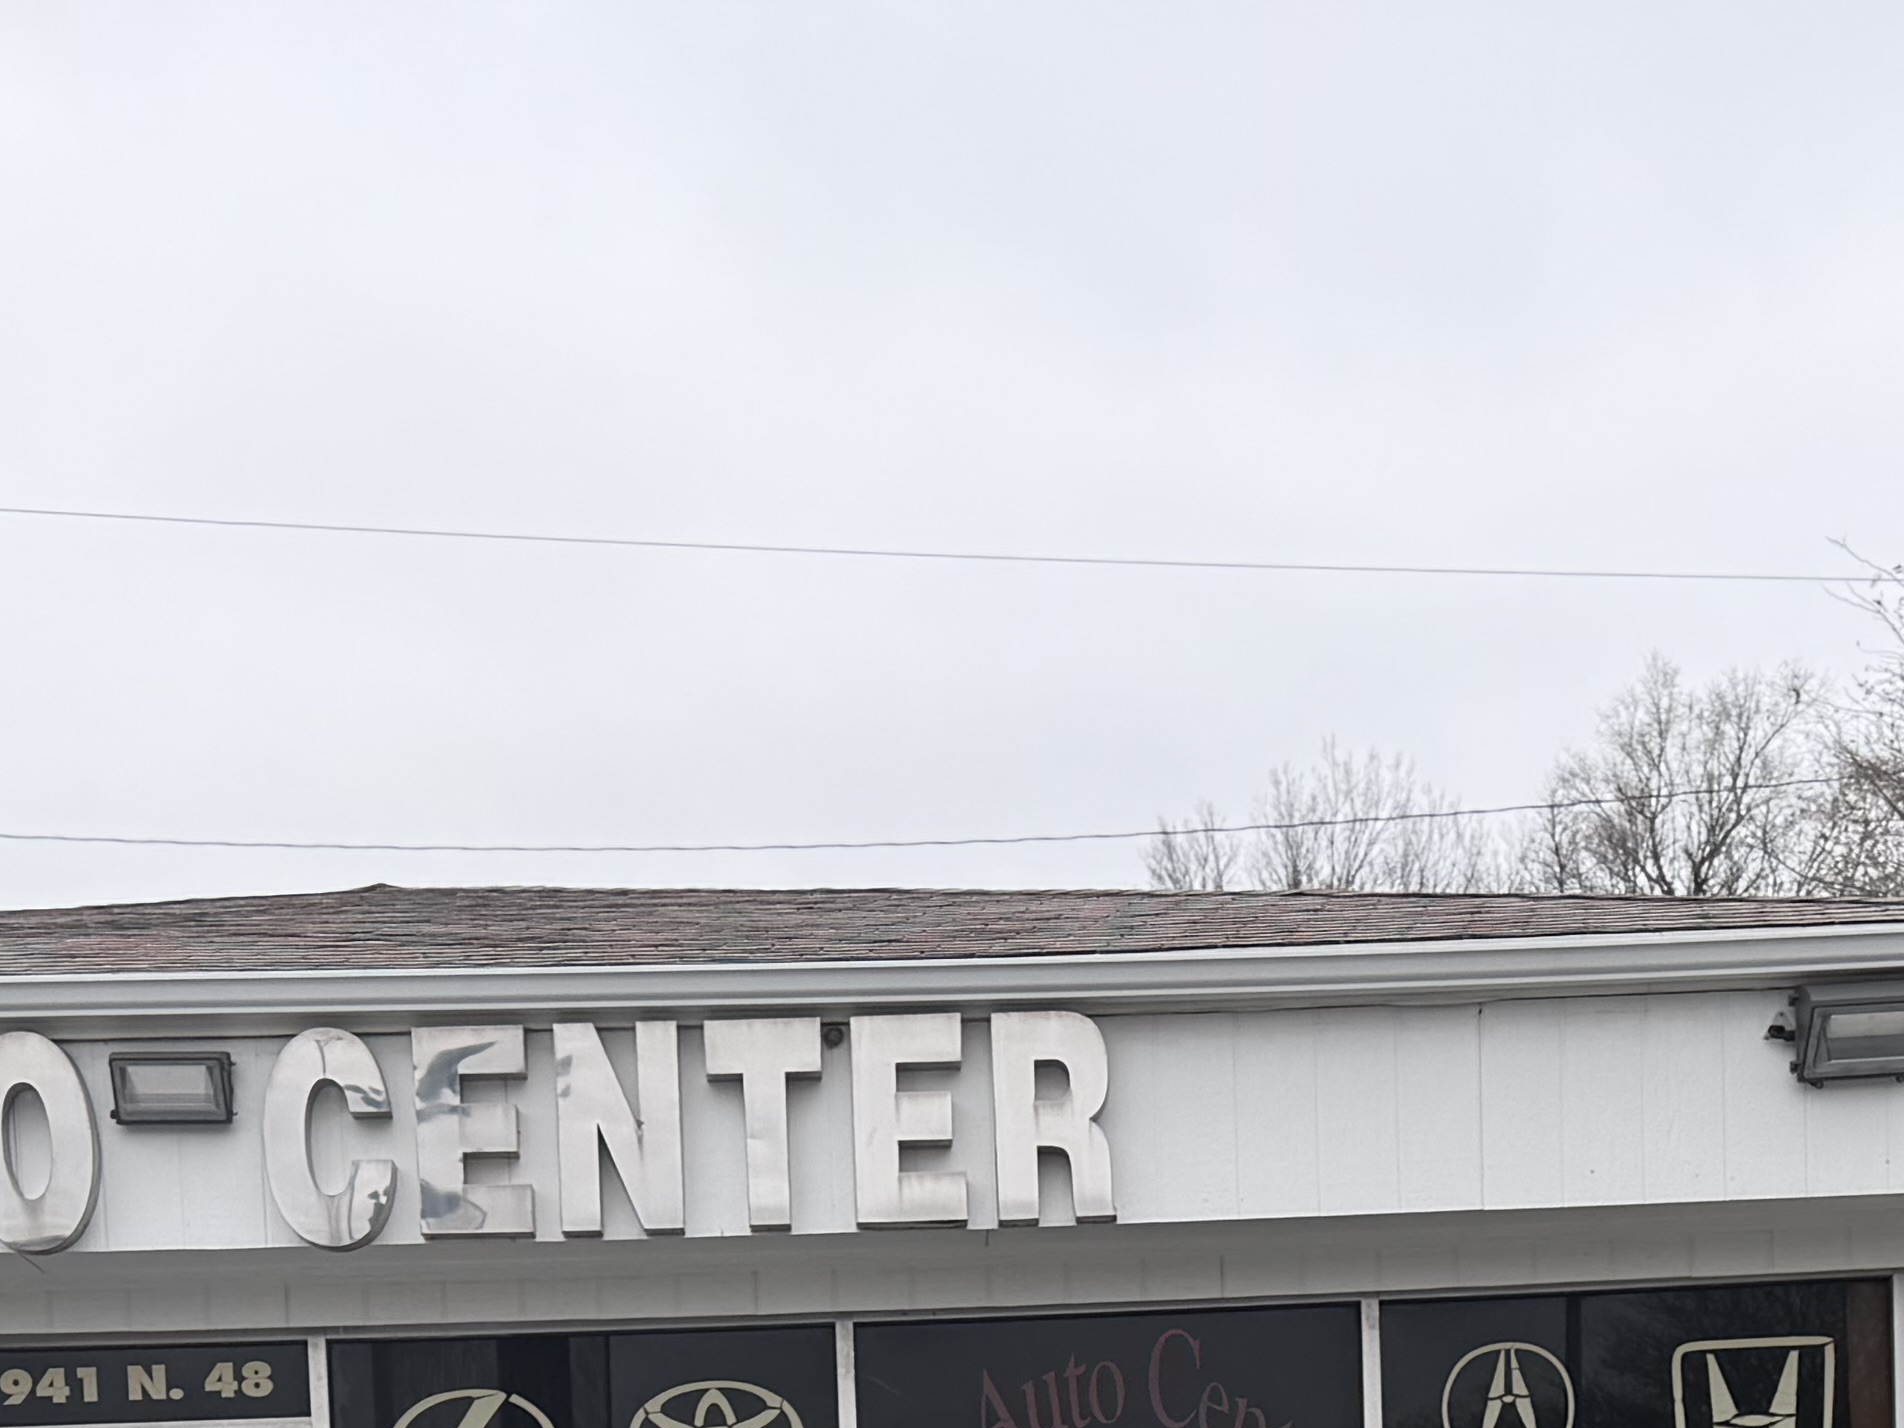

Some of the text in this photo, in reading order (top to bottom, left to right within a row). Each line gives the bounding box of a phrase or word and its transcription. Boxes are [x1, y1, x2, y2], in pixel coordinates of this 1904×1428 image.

[263, 1011, 1116, 1250] CENTER
[0, 1360, 274, 1405] 941 N. 48
